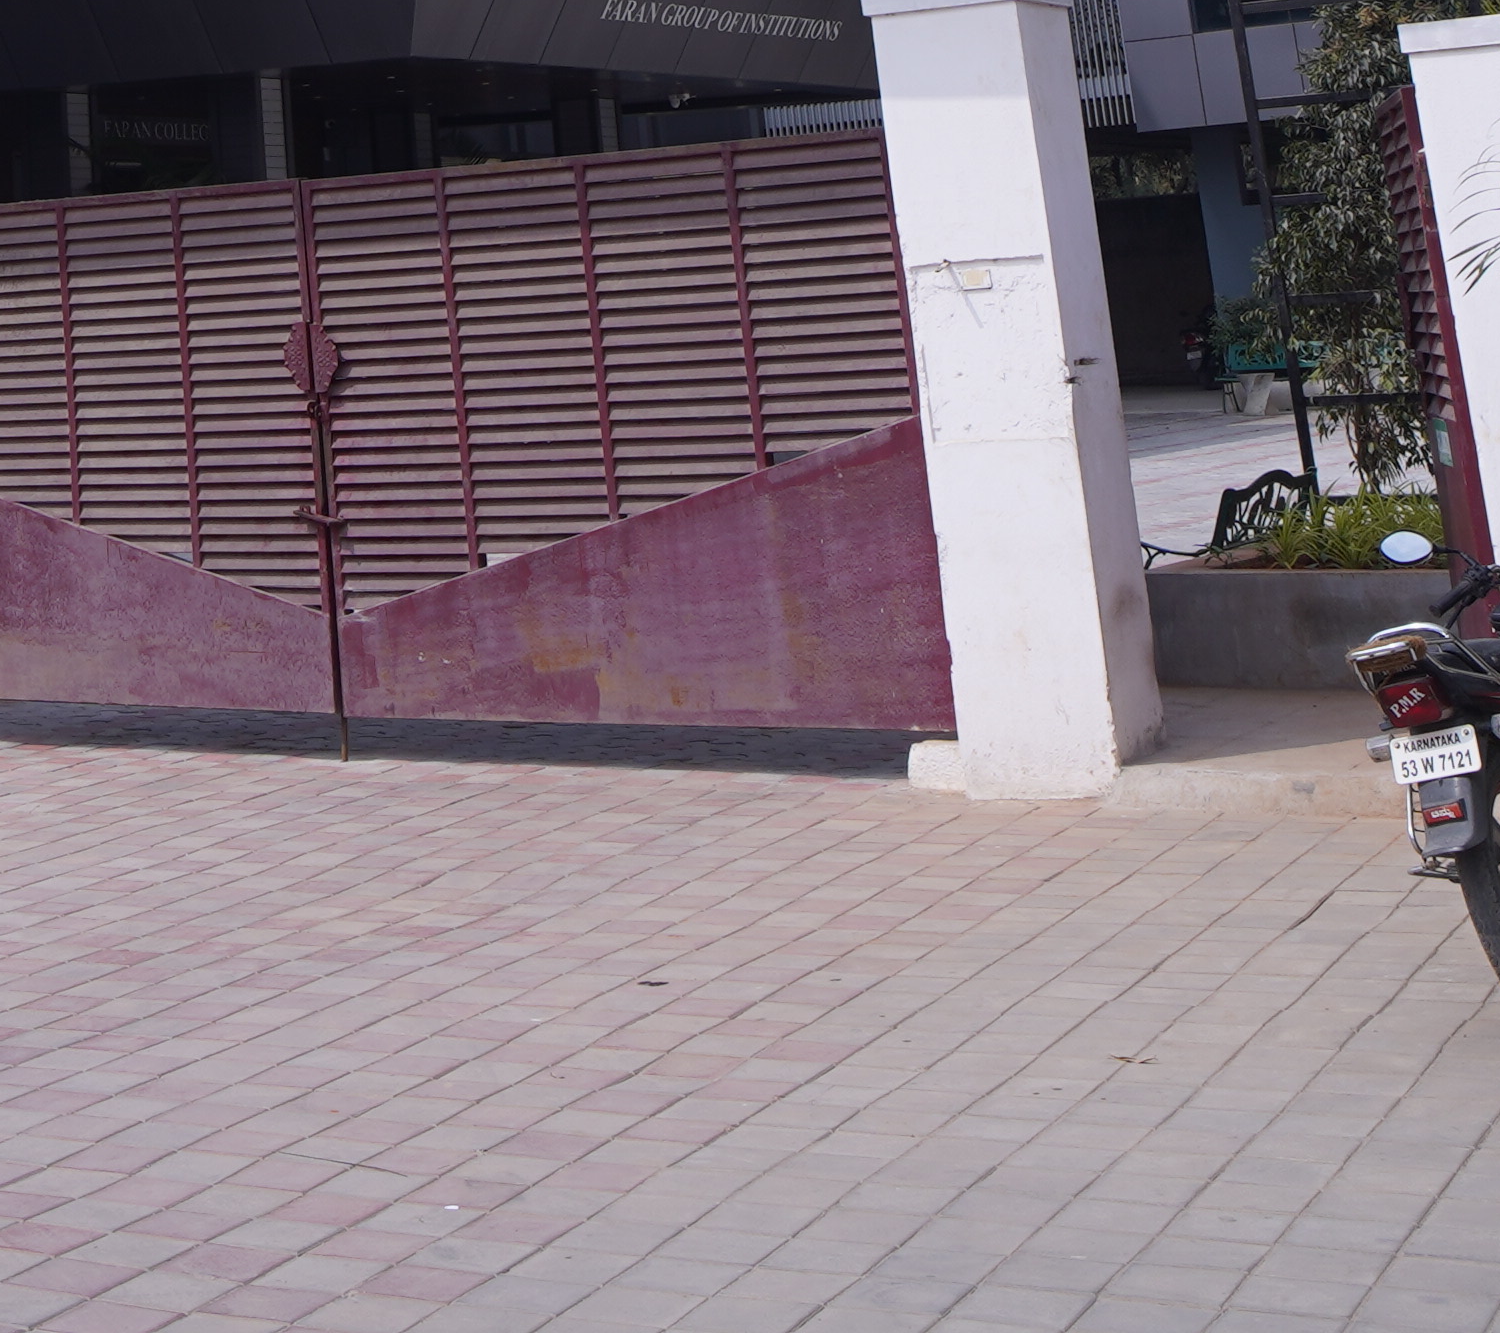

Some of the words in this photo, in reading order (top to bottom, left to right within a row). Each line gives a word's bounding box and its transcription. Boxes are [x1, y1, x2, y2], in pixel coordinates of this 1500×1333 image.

[661, 3, 720, 29] GROUP
[718, 10, 740, 33] OF
[739, 13, 842, 41] INSTITUTIONS
[1403, 733, 1461, 753] KARNATAKA
[1401, 759, 1419, 778] 53
[1421, 755, 1434, 775] W
[1438, 749, 1473, 771] 7121
